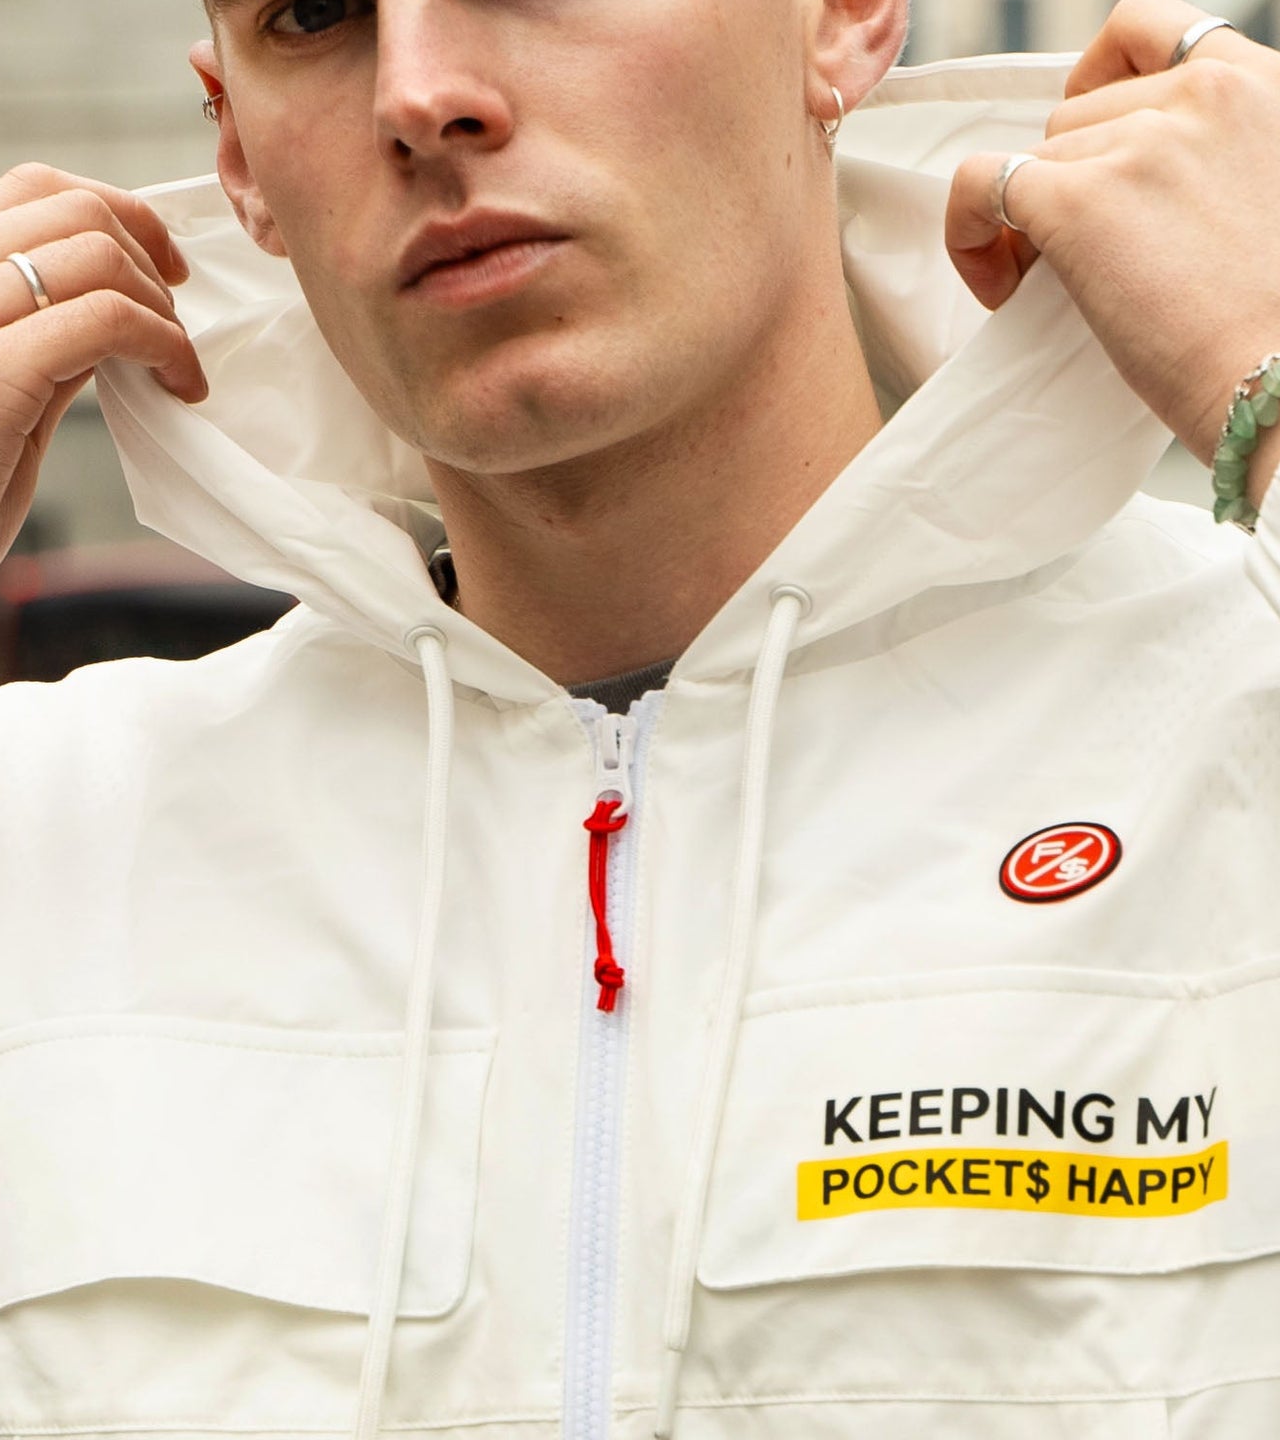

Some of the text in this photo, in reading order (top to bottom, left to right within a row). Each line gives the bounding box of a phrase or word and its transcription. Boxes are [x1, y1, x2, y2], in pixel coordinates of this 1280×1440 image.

[823, 1086, 1217, 1147] KEEPING MY
[822, 1155, 1215, 1207] POCKET$ HAPPY
